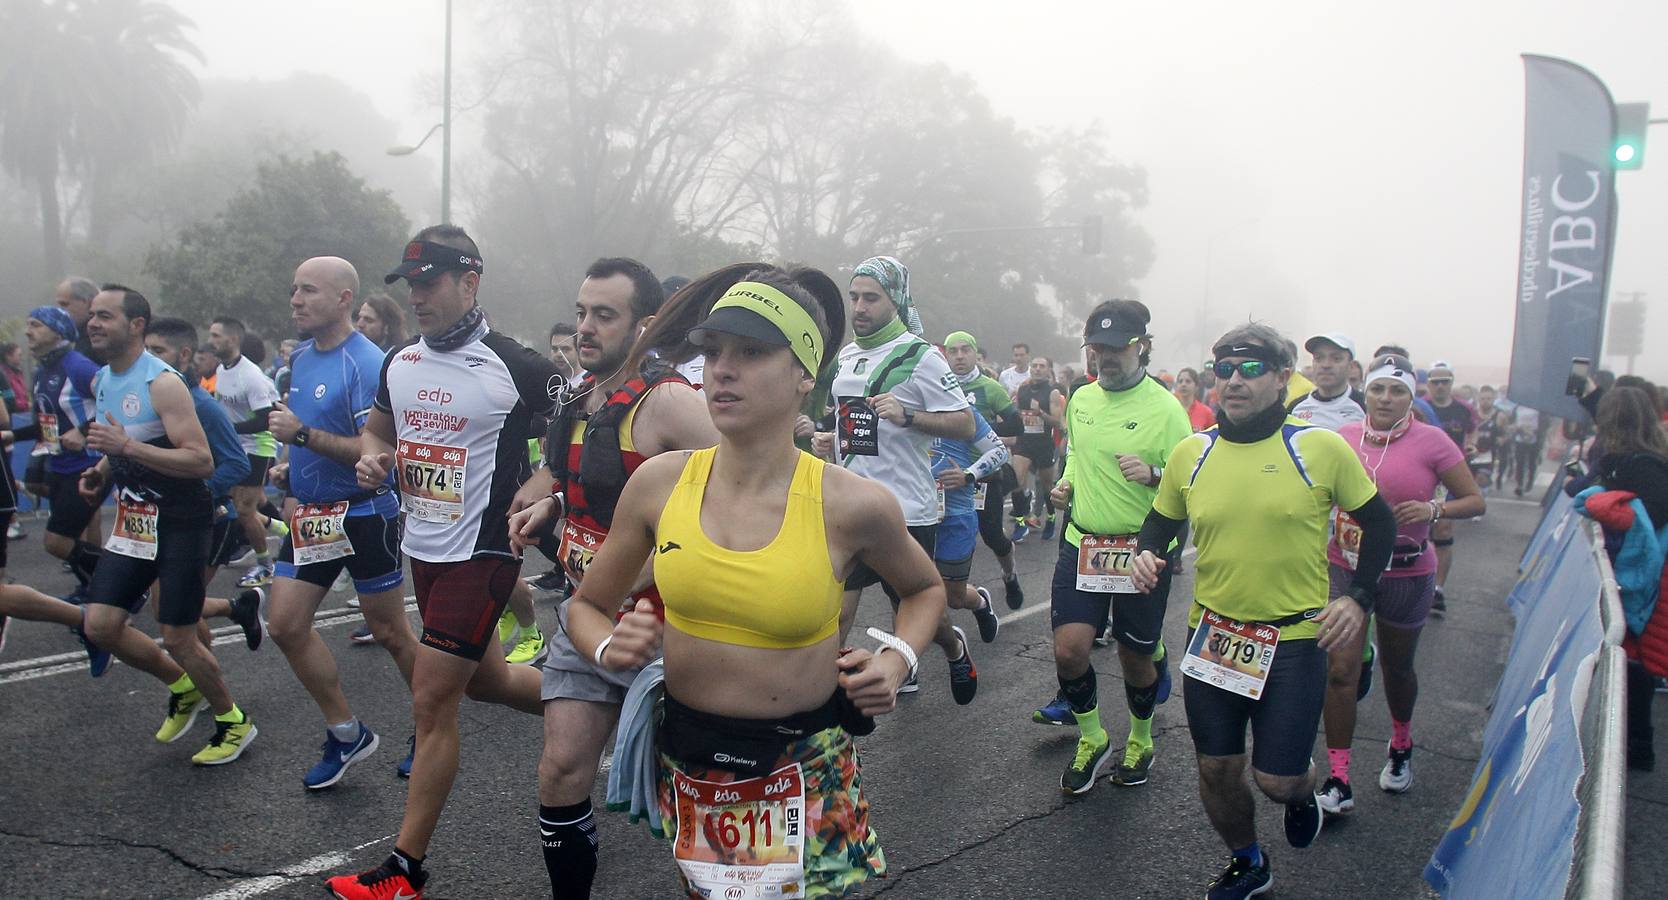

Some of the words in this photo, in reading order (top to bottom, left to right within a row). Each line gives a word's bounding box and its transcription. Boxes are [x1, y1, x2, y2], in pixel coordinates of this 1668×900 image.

[722, 290, 784, 316] URBEL
[417, 387, 453, 406] edp
[414, 410, 457, 423] maratón
[423, 419, 457, 432] sevilla
[416, 446, 431, 460] edp
[443, 450, 461, 463] edp
[405, 464, 447, 491] 6074
[1091, 552, 1131, 569] 4777
[1256, 629, 1273, 641] edp
[1209, 633, 1255, 664] 3019
[727, 889, 743, 898] KIA
